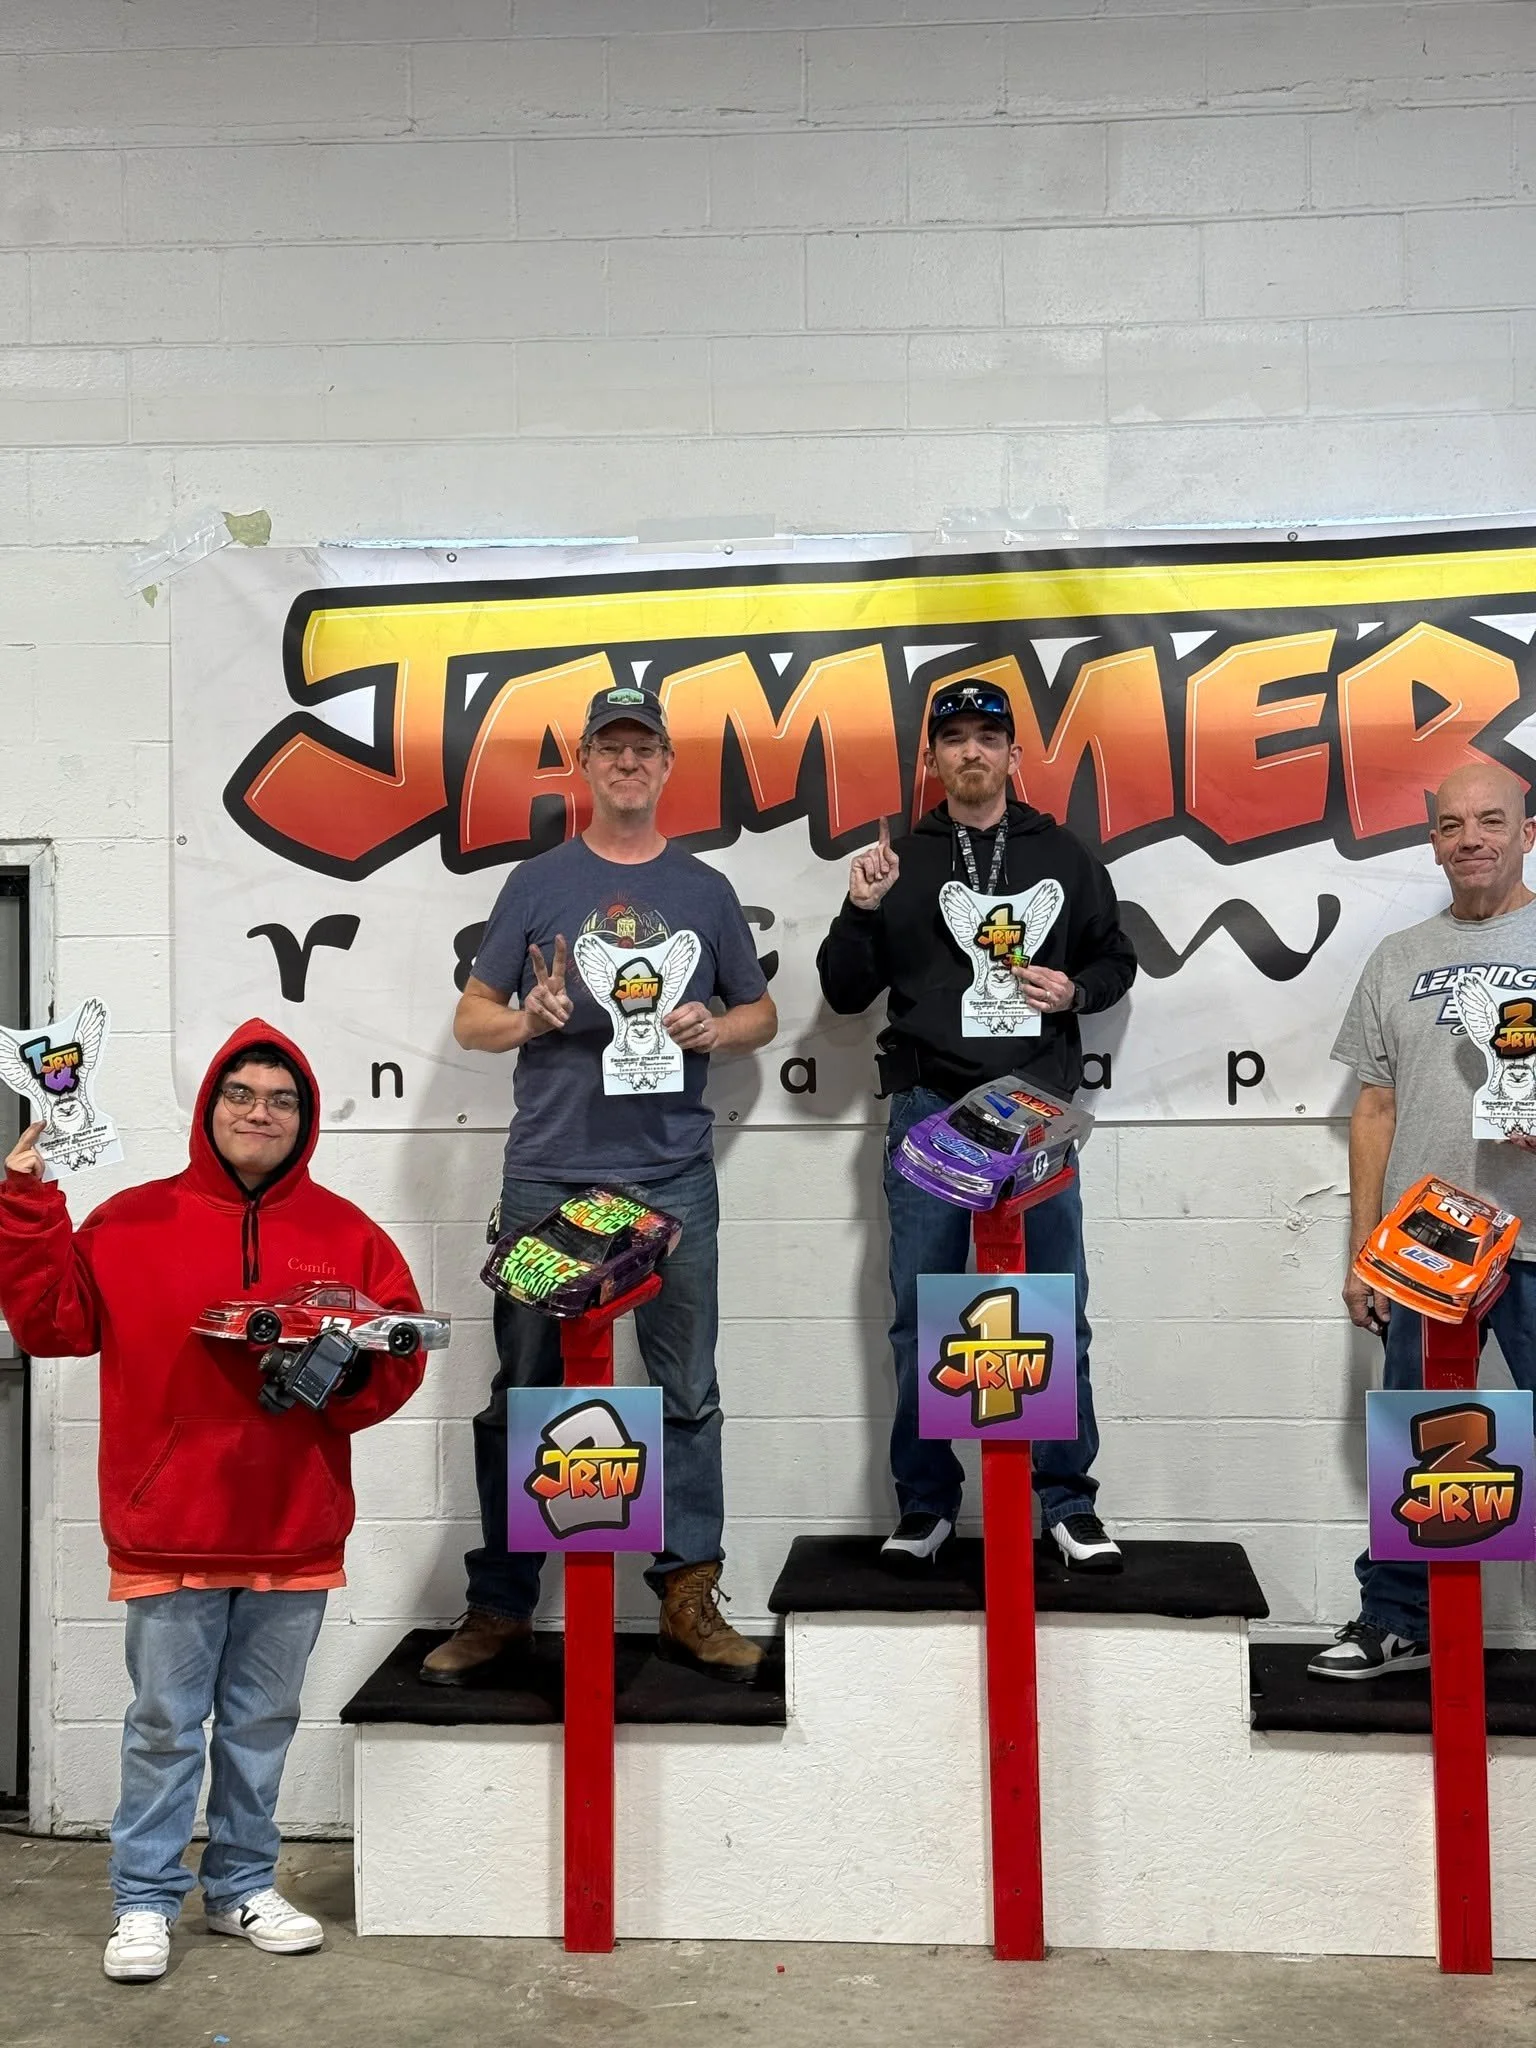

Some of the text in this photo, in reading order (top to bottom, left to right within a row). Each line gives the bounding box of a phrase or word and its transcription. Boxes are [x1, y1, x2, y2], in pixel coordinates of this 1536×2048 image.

[977, 925, 1022, 945] JRW
[614, 977, 659, 1000] JRW
[41, 1048, 79, 1074] JRW
[595, 1212, 629, 1235] GO
[510, 1235, 592, 1283] SPACE
[935, 1339, 1048, 1391] JRW
[966, 1294, 1016, 1422] 1
[531, 1448, 641, 1500] JRW
[1399, 1471, 1516, 1524] JRW
